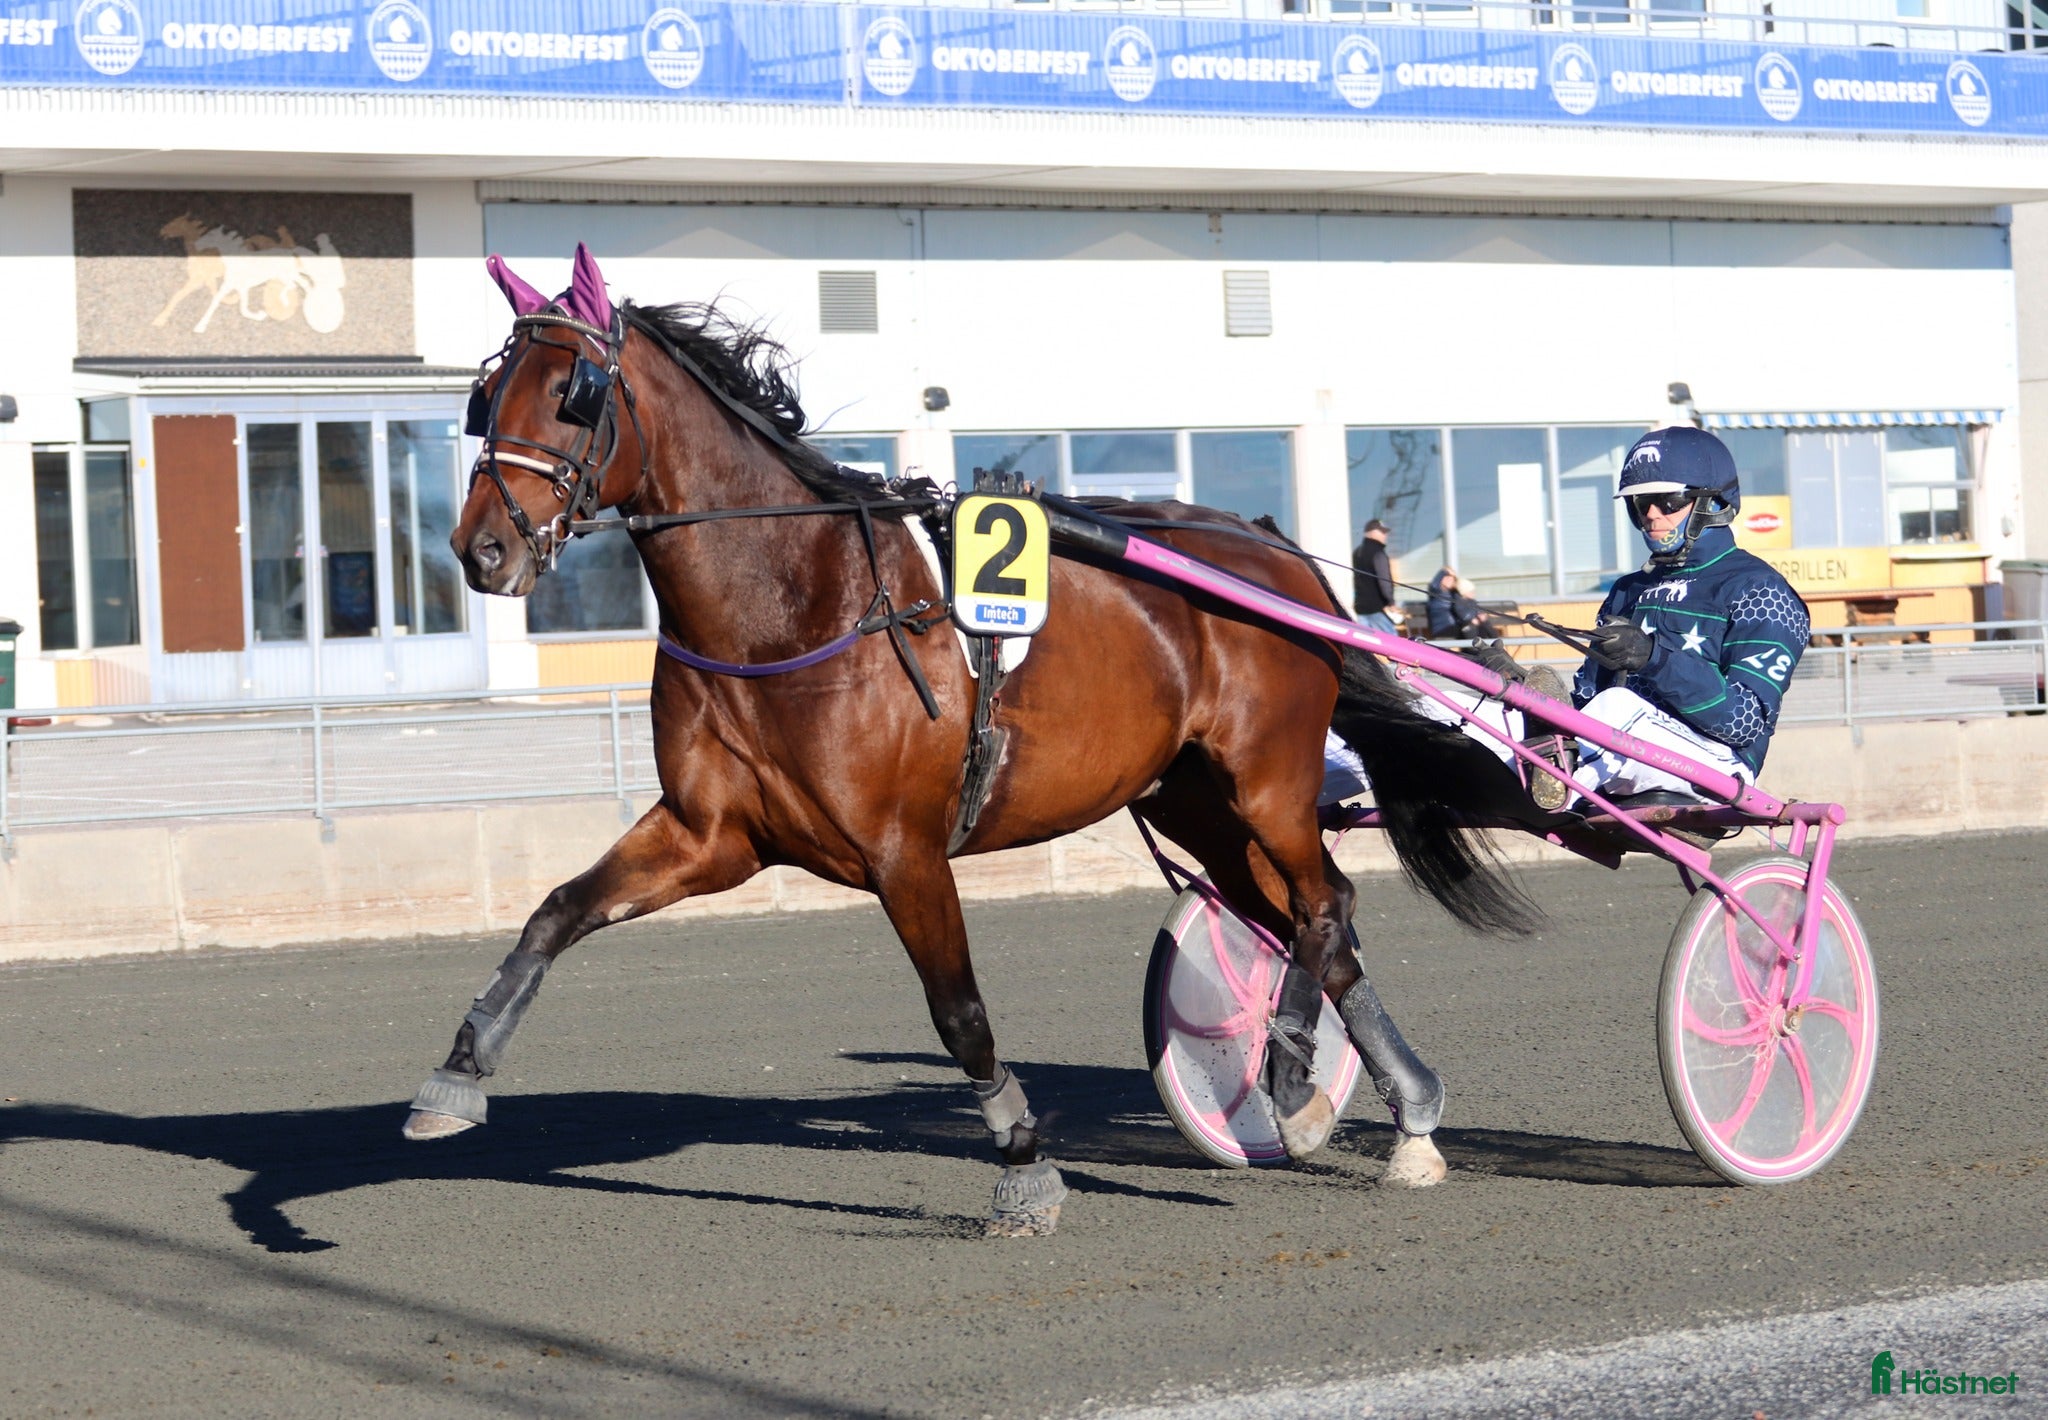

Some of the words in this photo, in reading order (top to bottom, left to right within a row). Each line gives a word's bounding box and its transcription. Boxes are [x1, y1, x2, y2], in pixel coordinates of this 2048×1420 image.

[163, 23, 352, 52] OKTOBERFEST
[449, 30, 628, 60] OKTOBERFEST
[933, 46, 1090, 75] OKTOBERFEST
[1171, 55, 1320, 82] OKTOBERFEST
[1396, 63, 1538, 89] OKTOBERFEST
[1612, 71, 1743, 97] OKTOBERFEST
[1814, 79, 1937, 102] OKTOBERFEST
[973, 503, 1027, 596] 2
[983, 607, 1020, 621] Imtech
